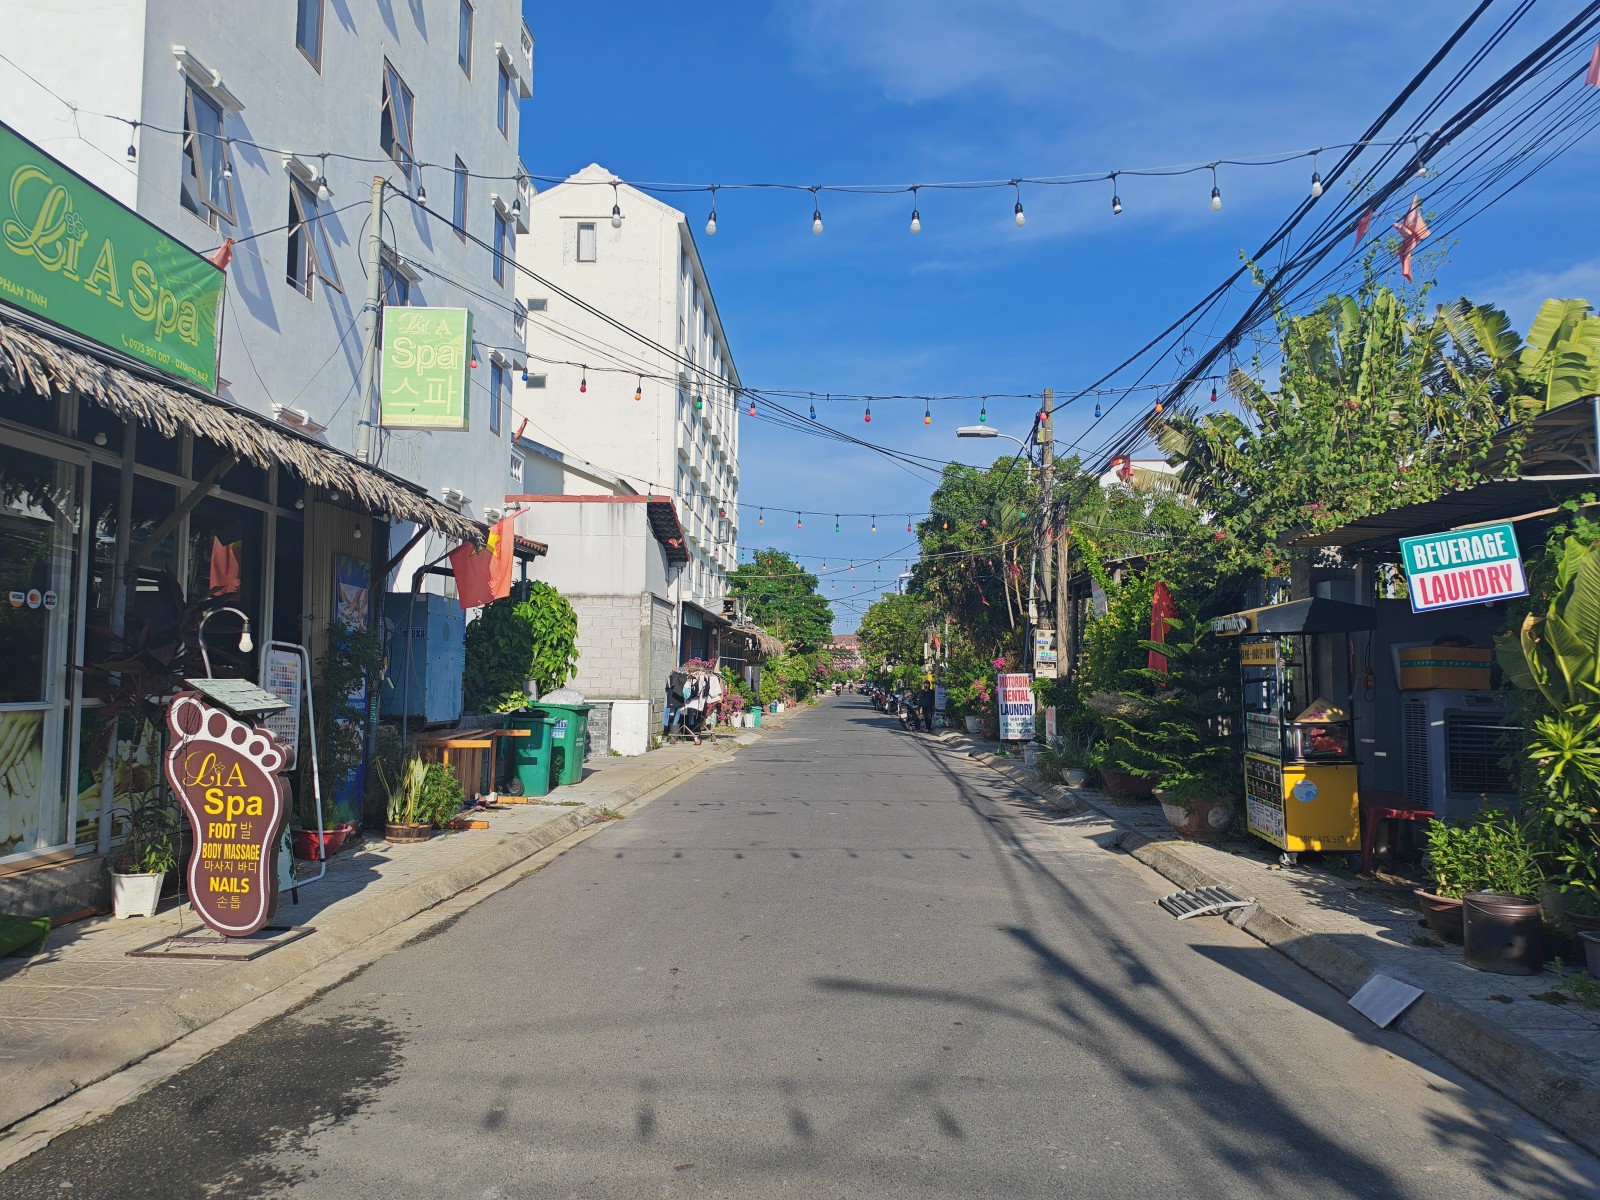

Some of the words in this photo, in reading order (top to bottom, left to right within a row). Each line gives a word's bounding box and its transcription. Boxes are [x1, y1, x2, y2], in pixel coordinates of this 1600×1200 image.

[128, 260, 200, 347] Spa
[435, 319, 453, 335] A
[129, 338, 145, 354] 0975
[146, 346, 157, 359] 301
[159, 352, 171, 364] 007
[391, 336, 458, 376] Spa
[387, 375, 457, 414] 스파
[1412, 531, 1509, 570] BEVERAGE
[1419, 563, 1513, 606] LAUNDRY
[1003, 690, 1029, 702] RENTAL
[1001, 703, 1033, 716] LAUNDRY
[204, 788, 262, 822] Spa
[208, 822, 236, 839] FOOT
[240, 821, 253, 840] 발
[202, 842, 222, 859] BODY
[224, 843, 261, 861] MASSAGE
[204, 861, 234, 874] 마사지
[237, 861, 258, 874] 바디
[209, 877, 250, 894] NAILS
[216, 895, 241, 909] 손톱
